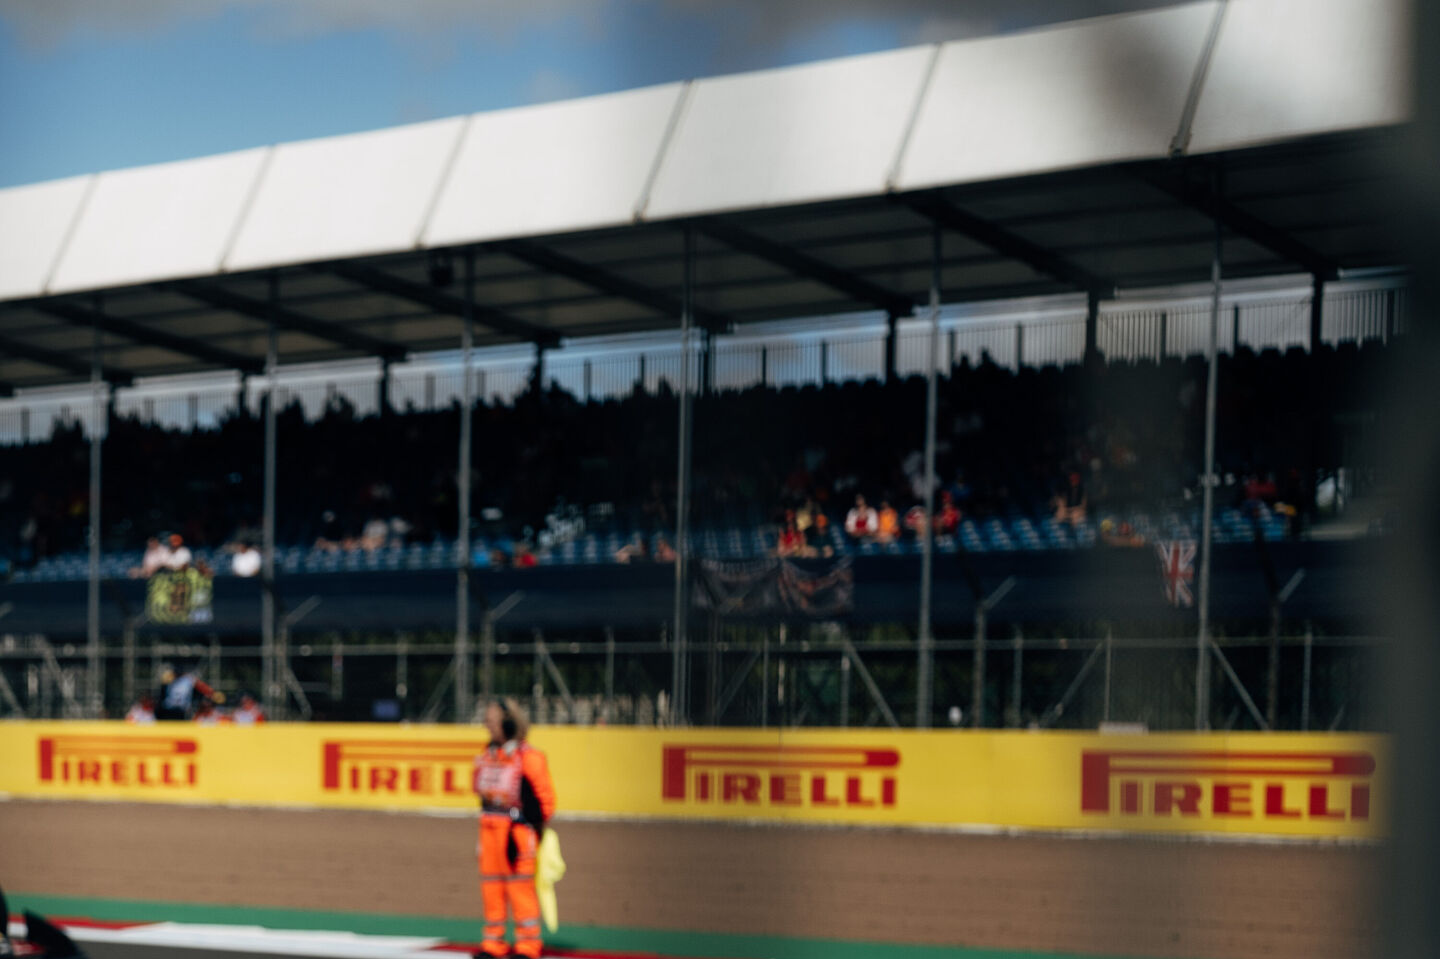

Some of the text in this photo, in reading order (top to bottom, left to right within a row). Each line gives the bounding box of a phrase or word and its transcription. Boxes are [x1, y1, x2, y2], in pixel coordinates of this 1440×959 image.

[38, 734, 199, 787] PIRELLI
[322, 739, 475, 796] PIREL
[662, 743, 902, 809] PIRELLI
[1081, 748, 1377, 821] PIRELLI
